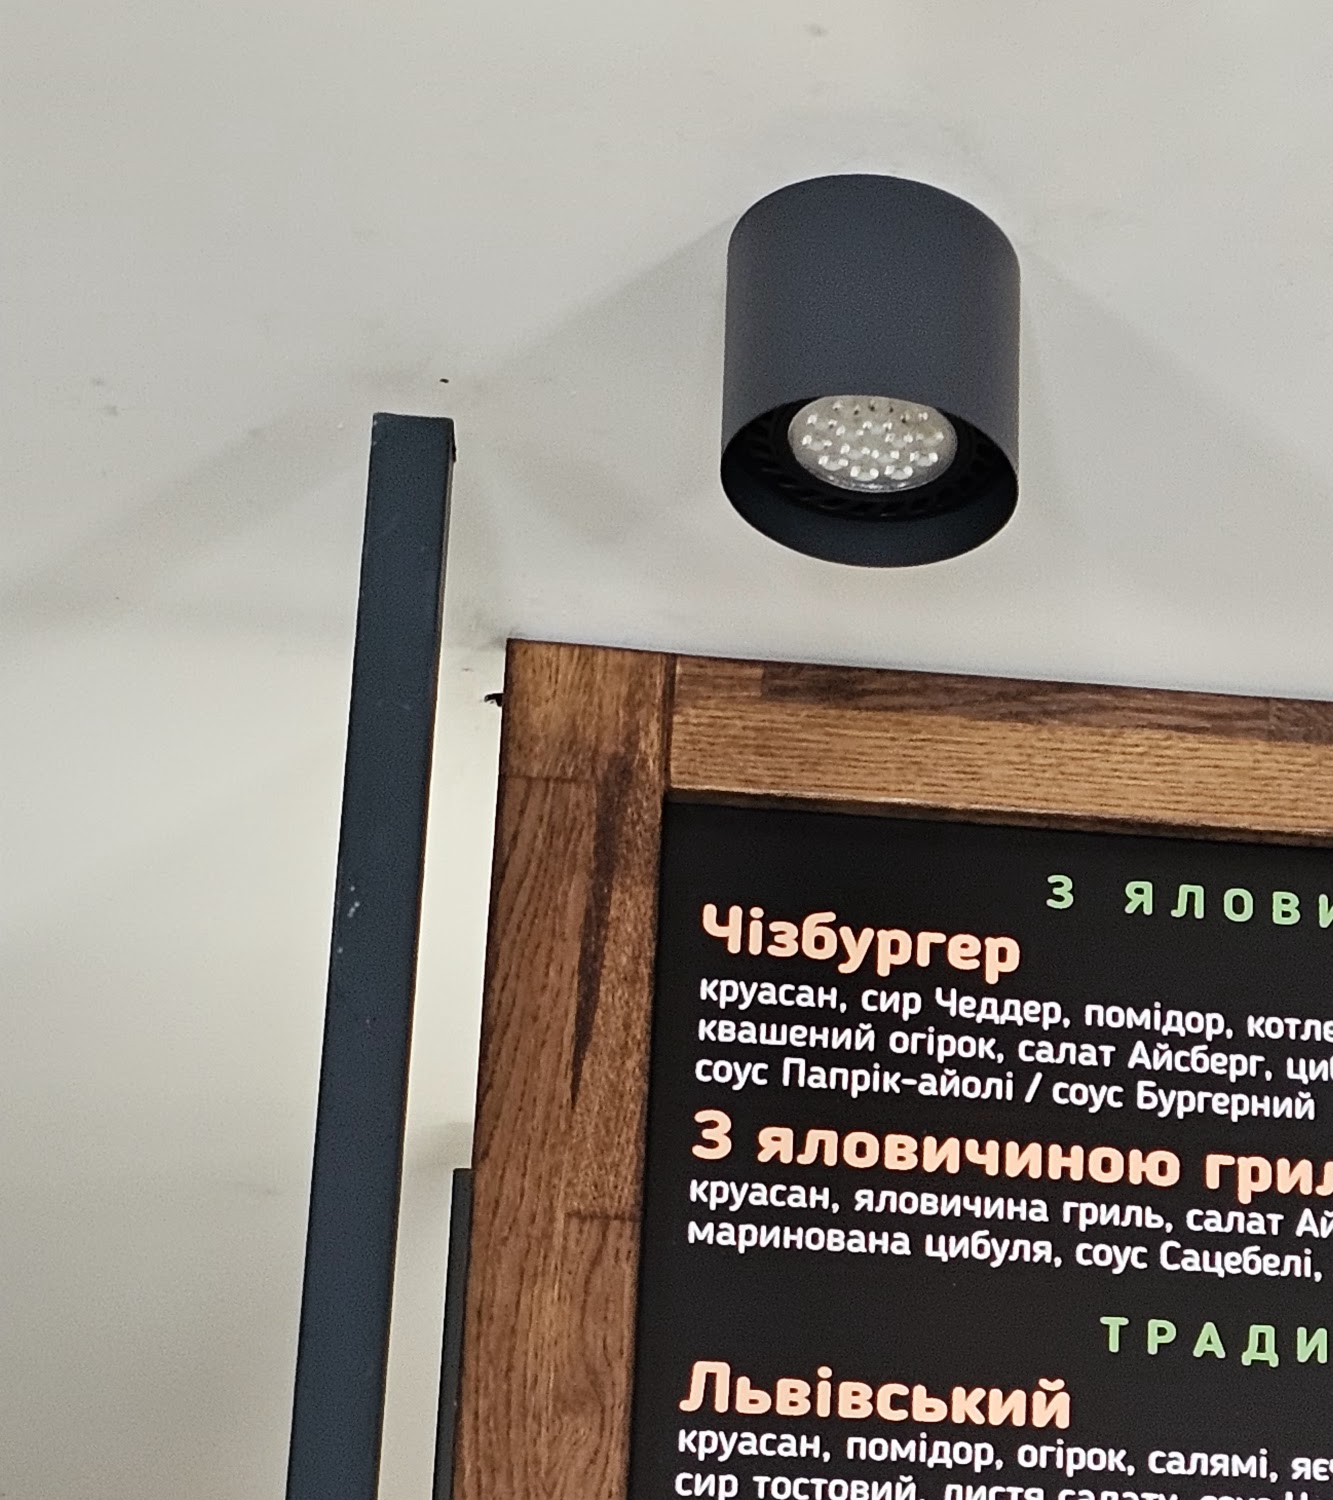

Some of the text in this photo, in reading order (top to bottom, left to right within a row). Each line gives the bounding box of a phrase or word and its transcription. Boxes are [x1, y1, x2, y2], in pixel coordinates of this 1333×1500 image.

[1045, 873, 1075, 911] З
[701, 902, 1022, 986] Чізбургер
[693, 1057, 770, 1092] соус
[781, 1055, 1015, 1102] Папрік-айолі
[1051, 1080, 1125, 1115] соус
[1135, 1078, 1316, 1124] Бургерний
[690, 1107, 733, 1161] З
[755, 1125, 1182, 1189] яловичиною
[686, 1219, 913, 1257] маринована
[923, 1228, 1064, 1270] цибуля,
[1074, 1241, 1149, 1276] соус
[1158, 1238, 1324, 1284] Сацебелі,
[677, 1359, 1072, 1431] Львівський
